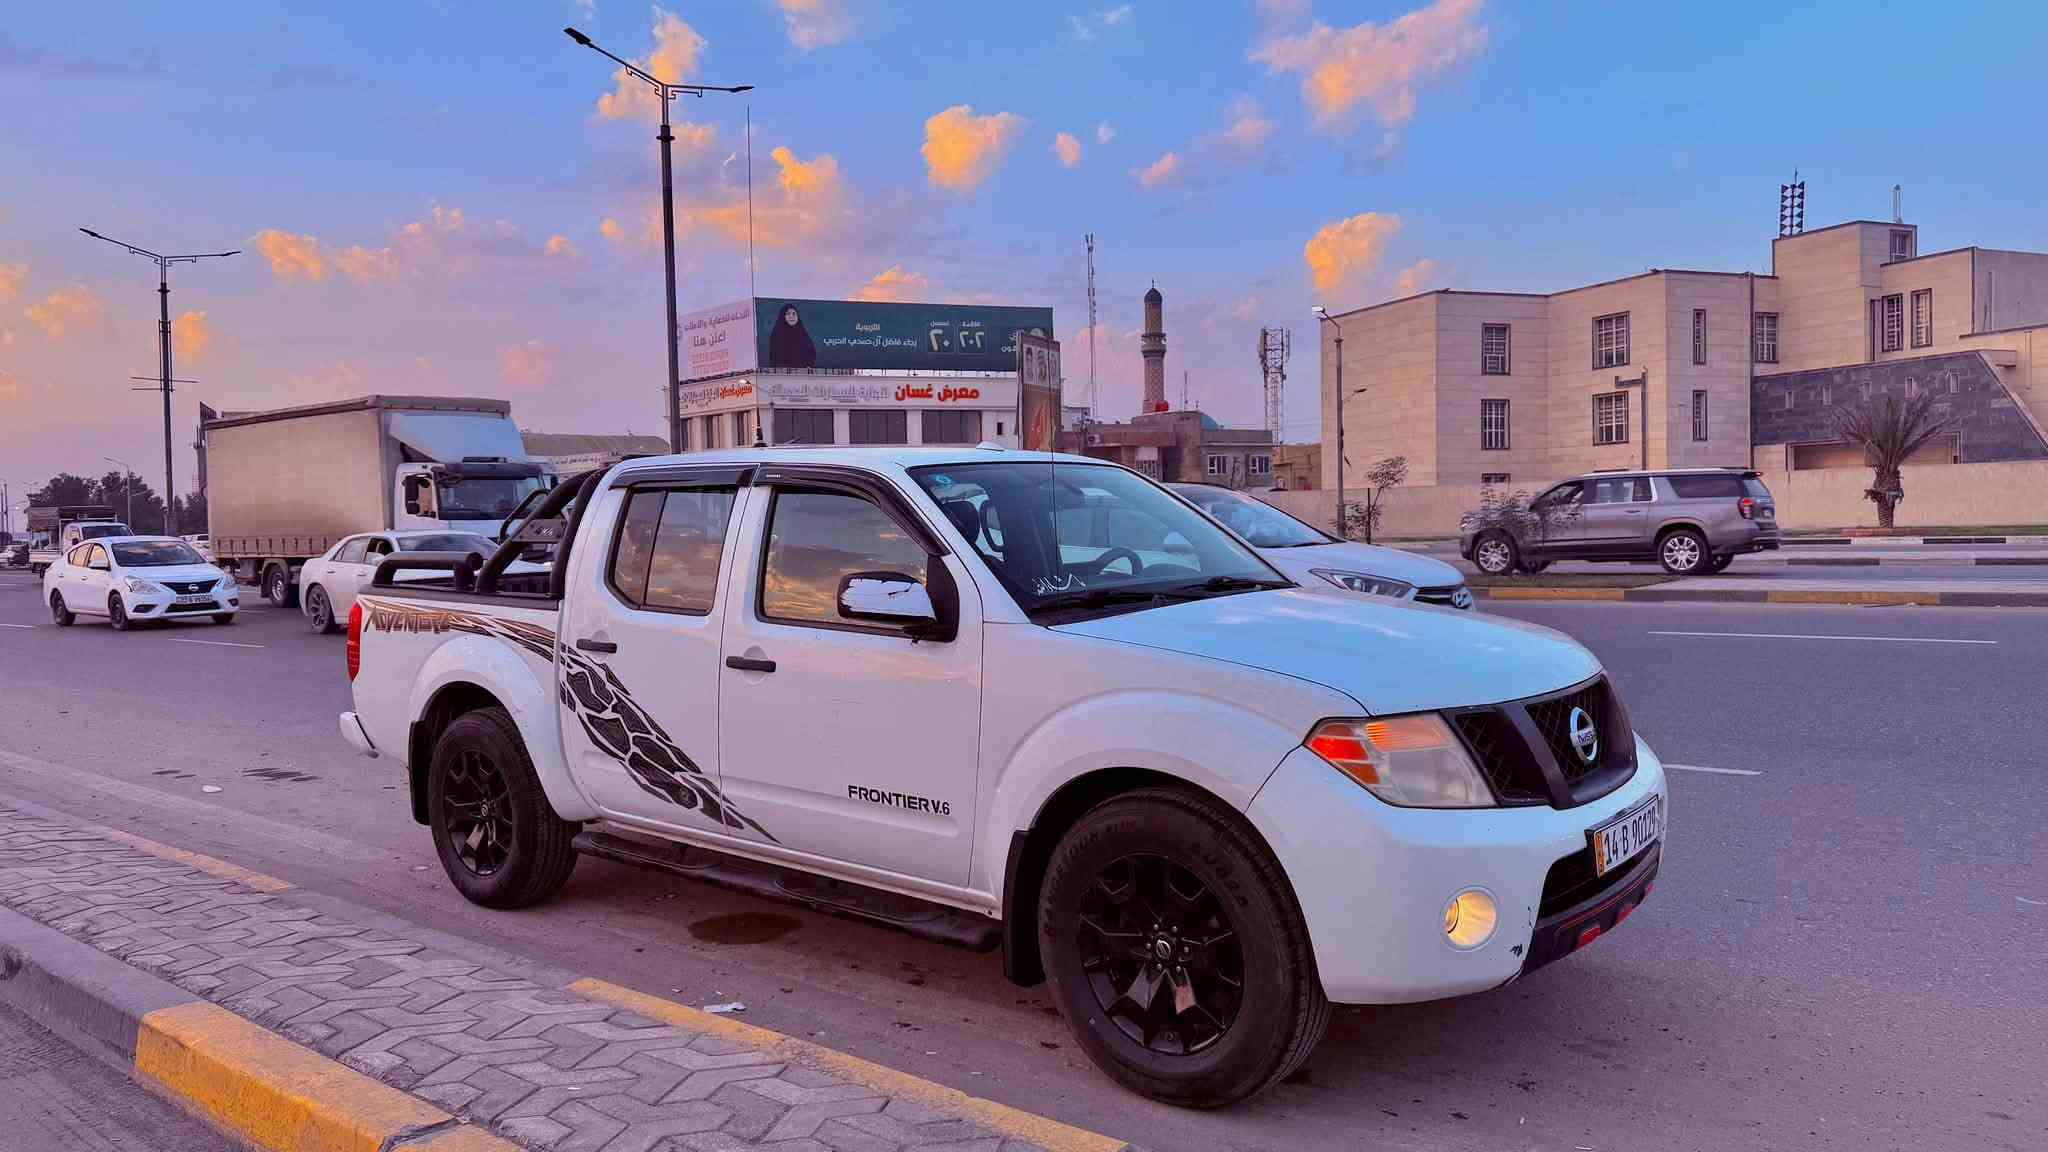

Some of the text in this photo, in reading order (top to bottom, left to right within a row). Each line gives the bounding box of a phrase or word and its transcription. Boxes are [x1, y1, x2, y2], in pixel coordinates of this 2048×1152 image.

[895, 384, 933, 401] غسان
[938, 385, 980, 402] معرض
[847, 784, 930, 813] FRONTIER
[1604, 830, 1619, 865] 14
